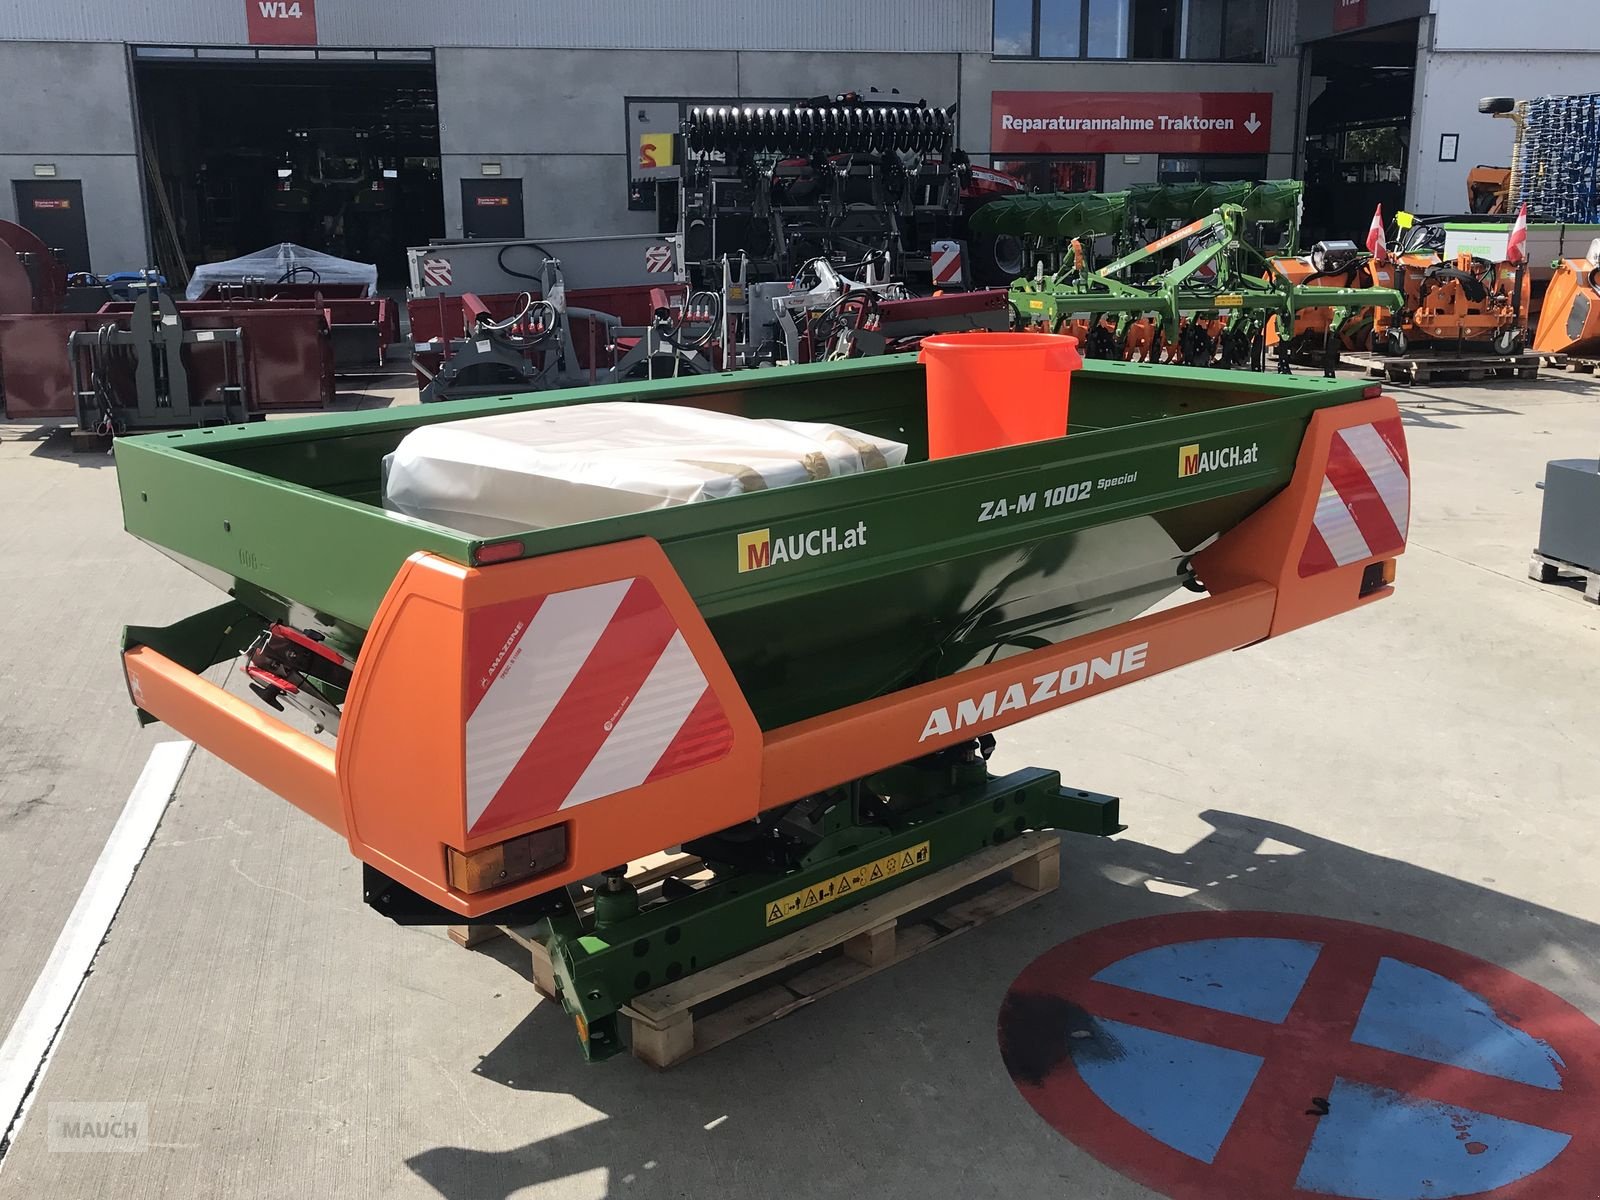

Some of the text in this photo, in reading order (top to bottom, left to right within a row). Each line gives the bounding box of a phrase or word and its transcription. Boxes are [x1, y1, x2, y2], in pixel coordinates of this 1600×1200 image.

[259, 2, 303, 18] W14
[1002, 115, 1234, 132] Reparaturannahme Traktoren
[1183, 443, 1259, 475] MAUCH.at
[978, 471, 1138, 522] ZA-M 1002 Special
[746, 521, 867, 570] MAUCH.at
[488, 621, 524, 676] AMAZONE
[918, 642, 1149, 743] AMAZONE
